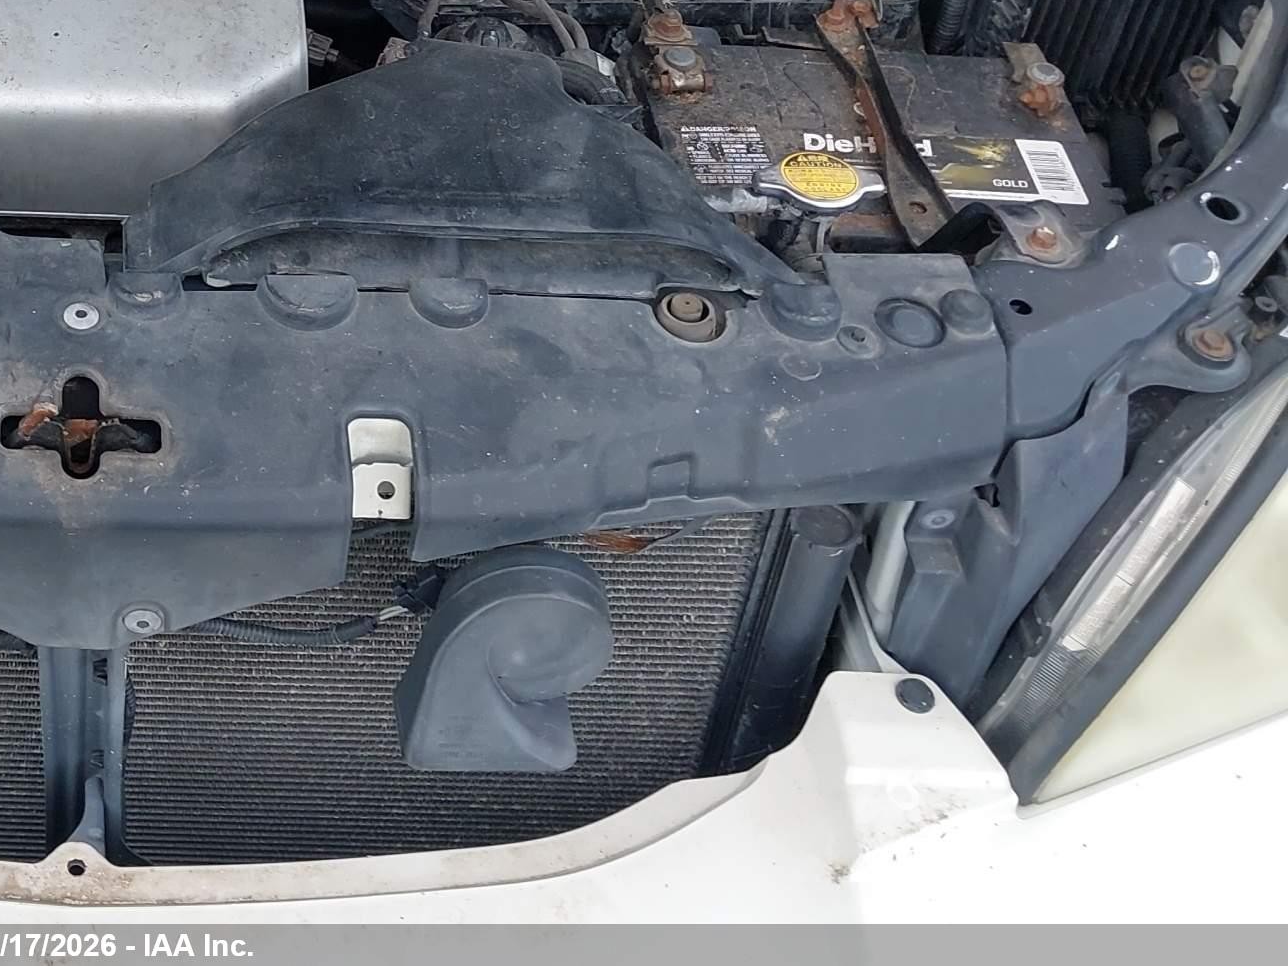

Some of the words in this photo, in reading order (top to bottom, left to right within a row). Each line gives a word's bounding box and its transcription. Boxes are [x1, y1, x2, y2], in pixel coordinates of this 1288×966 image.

[803, 132, 933, 157] DieHd
[790, 160, 843, 169] CAUTION
[992, 178, 1029, 189] GOLD
